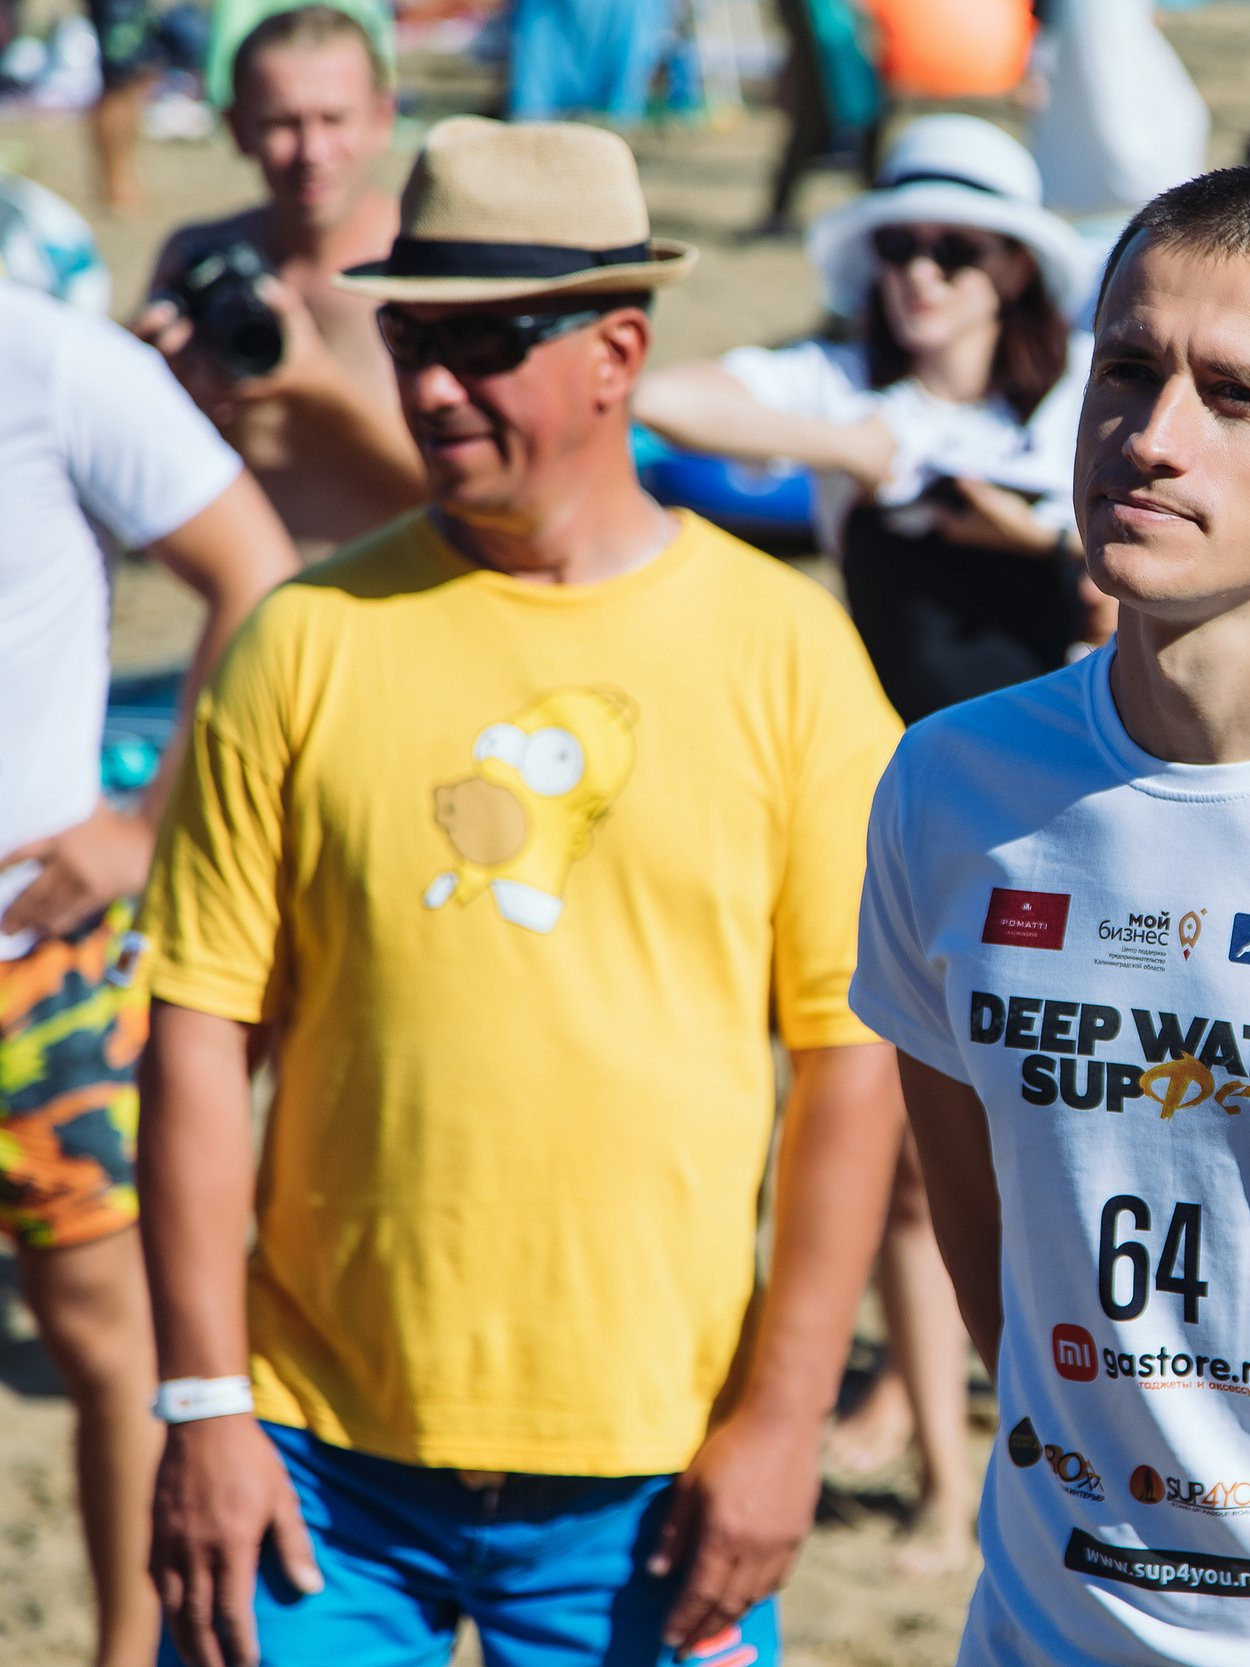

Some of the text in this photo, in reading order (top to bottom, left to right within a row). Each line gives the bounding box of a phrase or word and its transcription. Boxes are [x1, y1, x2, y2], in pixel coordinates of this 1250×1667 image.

[1001, 919, 1048, 930] POMATTI
[1098, 919, 1170, 946] бизнес
[1128, 910, 1171, 931] мой
[970, 991, 1122, 1056] DEEP
[1099, 1195, 1209, 1325] 64
[1138, 1381, 1192, 1391] гаджеты
[1196, 1382, 1204, 1390] и
